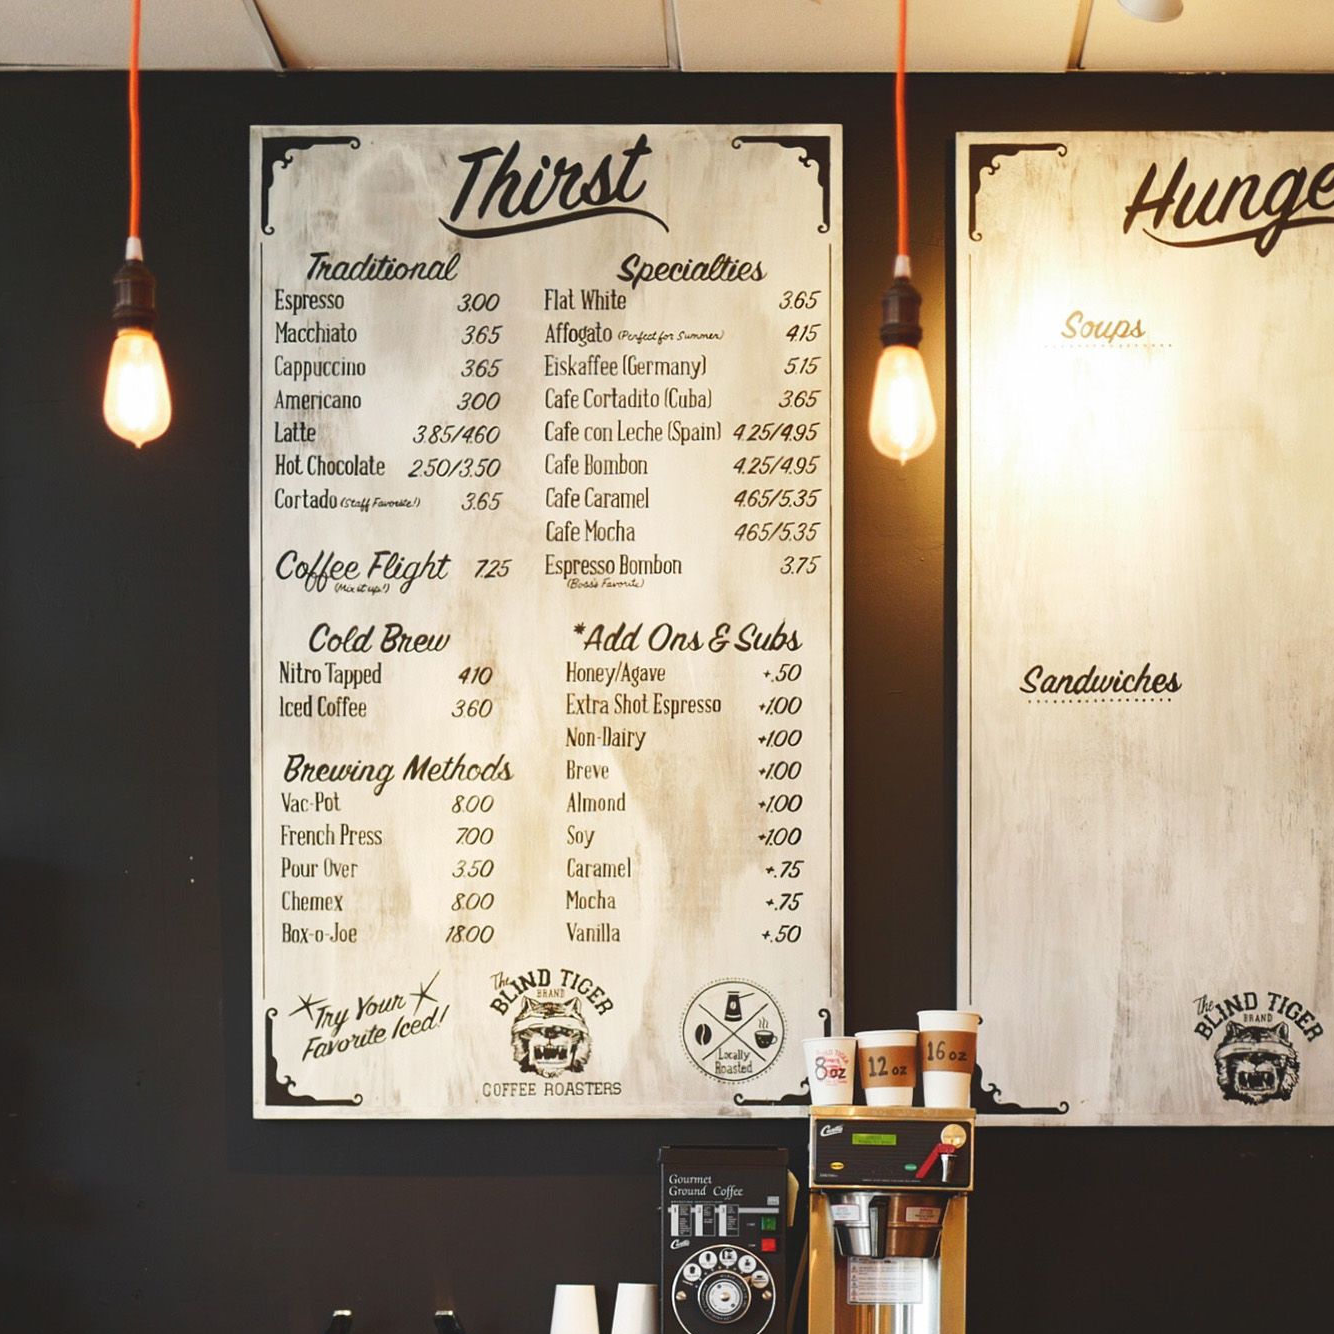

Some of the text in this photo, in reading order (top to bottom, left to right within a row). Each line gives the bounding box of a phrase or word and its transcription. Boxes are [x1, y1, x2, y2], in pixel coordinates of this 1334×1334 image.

[449, 133, 654, 222] Thirst
[306, 251, 461, 281] Traditional
[616, 253, 768, 290] Specialties
[274, 288, 500, 315] Espresso 3.00
[544, 288, 822, 311] Flat White 3.65
[275, 321, 357, 343] Macchiato
[545, 321, 821, 347] Affogato 4.15
[1060, 310, 1146, 344] Soups
[274, 355, 366, 381] Cappuccino
[544, 355, 822, 380] Eiskaffee (Germany) 5.15
[274, 389, 361, 410] Americano
[545, 387, 822, 409] Cafe Cortadito (Cuba) 3.65
[274, 420, 316, 443] Latte
[545, 420, 820, 446] Cafe con Leche (Spain) 4.25/4.95
[275, 454, 385, 476] Hot Chocolate
[545, 453, 820, 475] Cafe Bombon 4.25/4.95
[274, 488, 338, 509] Cortado
[461, 492, 503, 511] 3.65
[546, 486, 822, 509] Cafe Caramel 4.65/5.35
[546, 519, 636, 542] Cafe Mocha
[275, 549, 513, 594] Coffee Flight 7.25
[545, 554, 821, 579] Espresso Bombon 3.75
[309, 622, 451, 653] Cold Brew
[648, 622, 704, 651] Ons
[708, 622, 731, 653] &
[734, 620, 803, 652] Subs
[279, 661, 382, 689] Nitro Tapped
[566, 661, 666, 687] Honey/Agave
[1019, 662, 1182, 695] Sandwiches
[279, 695, 367, 717] Iced Coffee
[566, 693, 609, 715] Extra
[614, 693, 649, 714] Shot
[653, 693, 722, 719] Espresso
[566, 726, 647, 751] Non-Dairy
[283, 753, 514, 796] Brewing Methods
[566, 759, 609, 780] Breve
[280, 791, 342, 812] Vac-Pot
[566, 792, 626, 813] Almond
[280, 823, 383, 846] French Press
[567, 825, 595, 849] Soy
[280, 857, 358, 878] Pour Over
[567, 857, 632, 878] Caramel
[281, 891, 344, 911] Chemex
[566, 890, 616, 910] Mocha
[281, 922, 358, 944] Box-o-Joe
[566, 922, 621, 942] Vanilla
[489, 968, 614, 1016] BLIND TIGER
[314, 993, 407, 1036] Try Your
[1192, 994, 1214, 1016] The
[1194, 991, 1324, 1042] BLIND TIGER
[1243, 1013, 1273, 1022] BRAND
[302, 1004, 450, 1063] Favorite Iced!
[718, 1048, 750, 1063] Locally
[927, 1040, 967, 1062] 16 oz
[715, 1061, 753, 1075] Roasted
[815, 1056, 846, 1081] 8 oz
[868, 1055, 908, 1077] 12 oz
[482, 1082, 622, 1097] COFFEE ROASTERS
[668, 1173, 712, 1185] Gourmet
[668, 1185, 744, 1199] Ground Coffee
